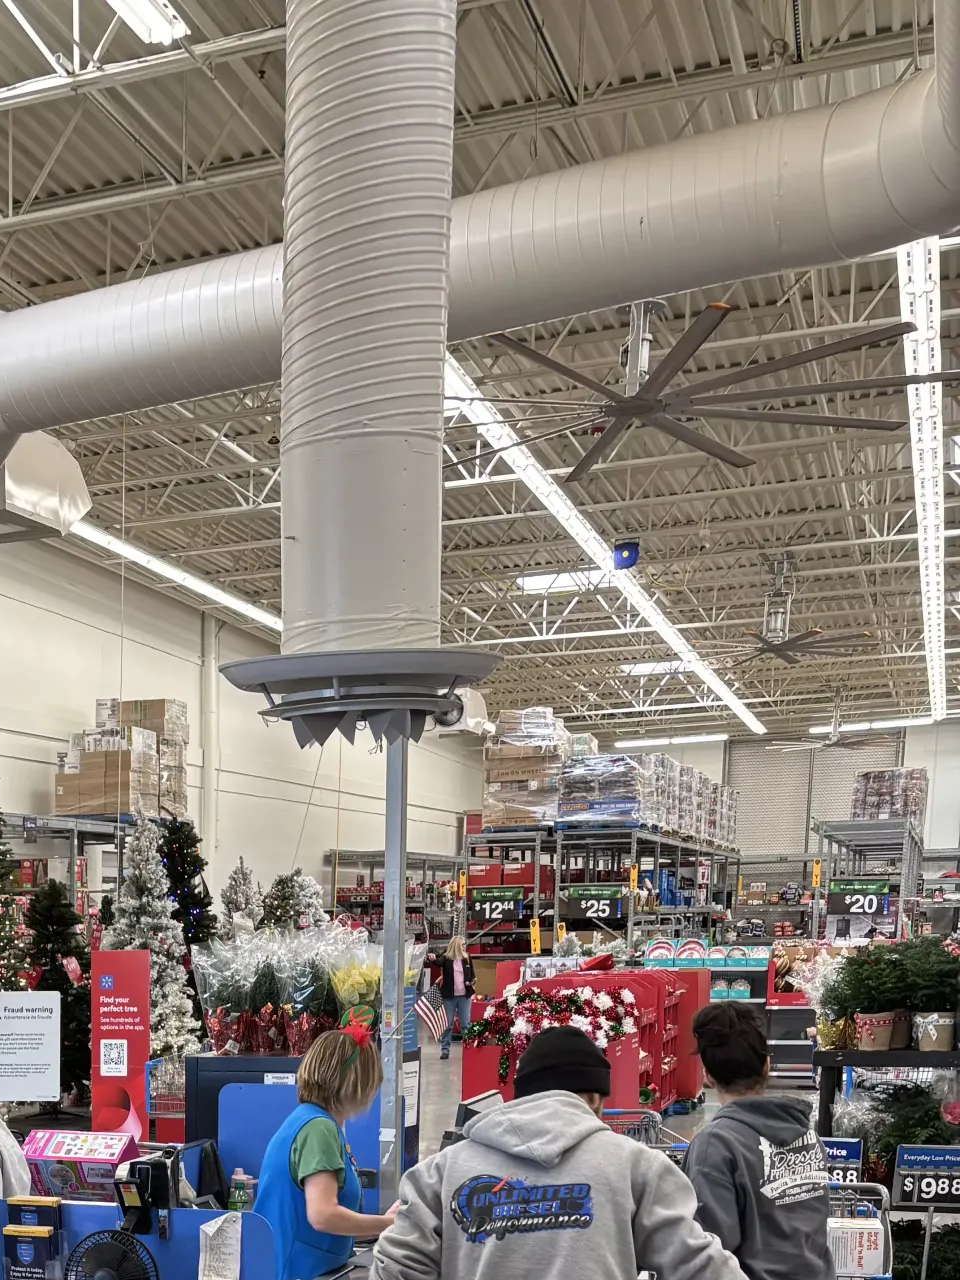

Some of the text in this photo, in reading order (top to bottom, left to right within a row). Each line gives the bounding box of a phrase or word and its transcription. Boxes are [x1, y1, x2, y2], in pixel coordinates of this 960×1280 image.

[581, 900, 610, 918] $25
[845, 895, 877, 913] $20
[100, 1005, 123, 1013] perfect
[904, 1177, 913, 1192] $
[472, 1185, 588, 1208] UNLIMITED
[493, 1201, 560, 1218] DIESEL
[469, 1215, 590, 1241] Performance
